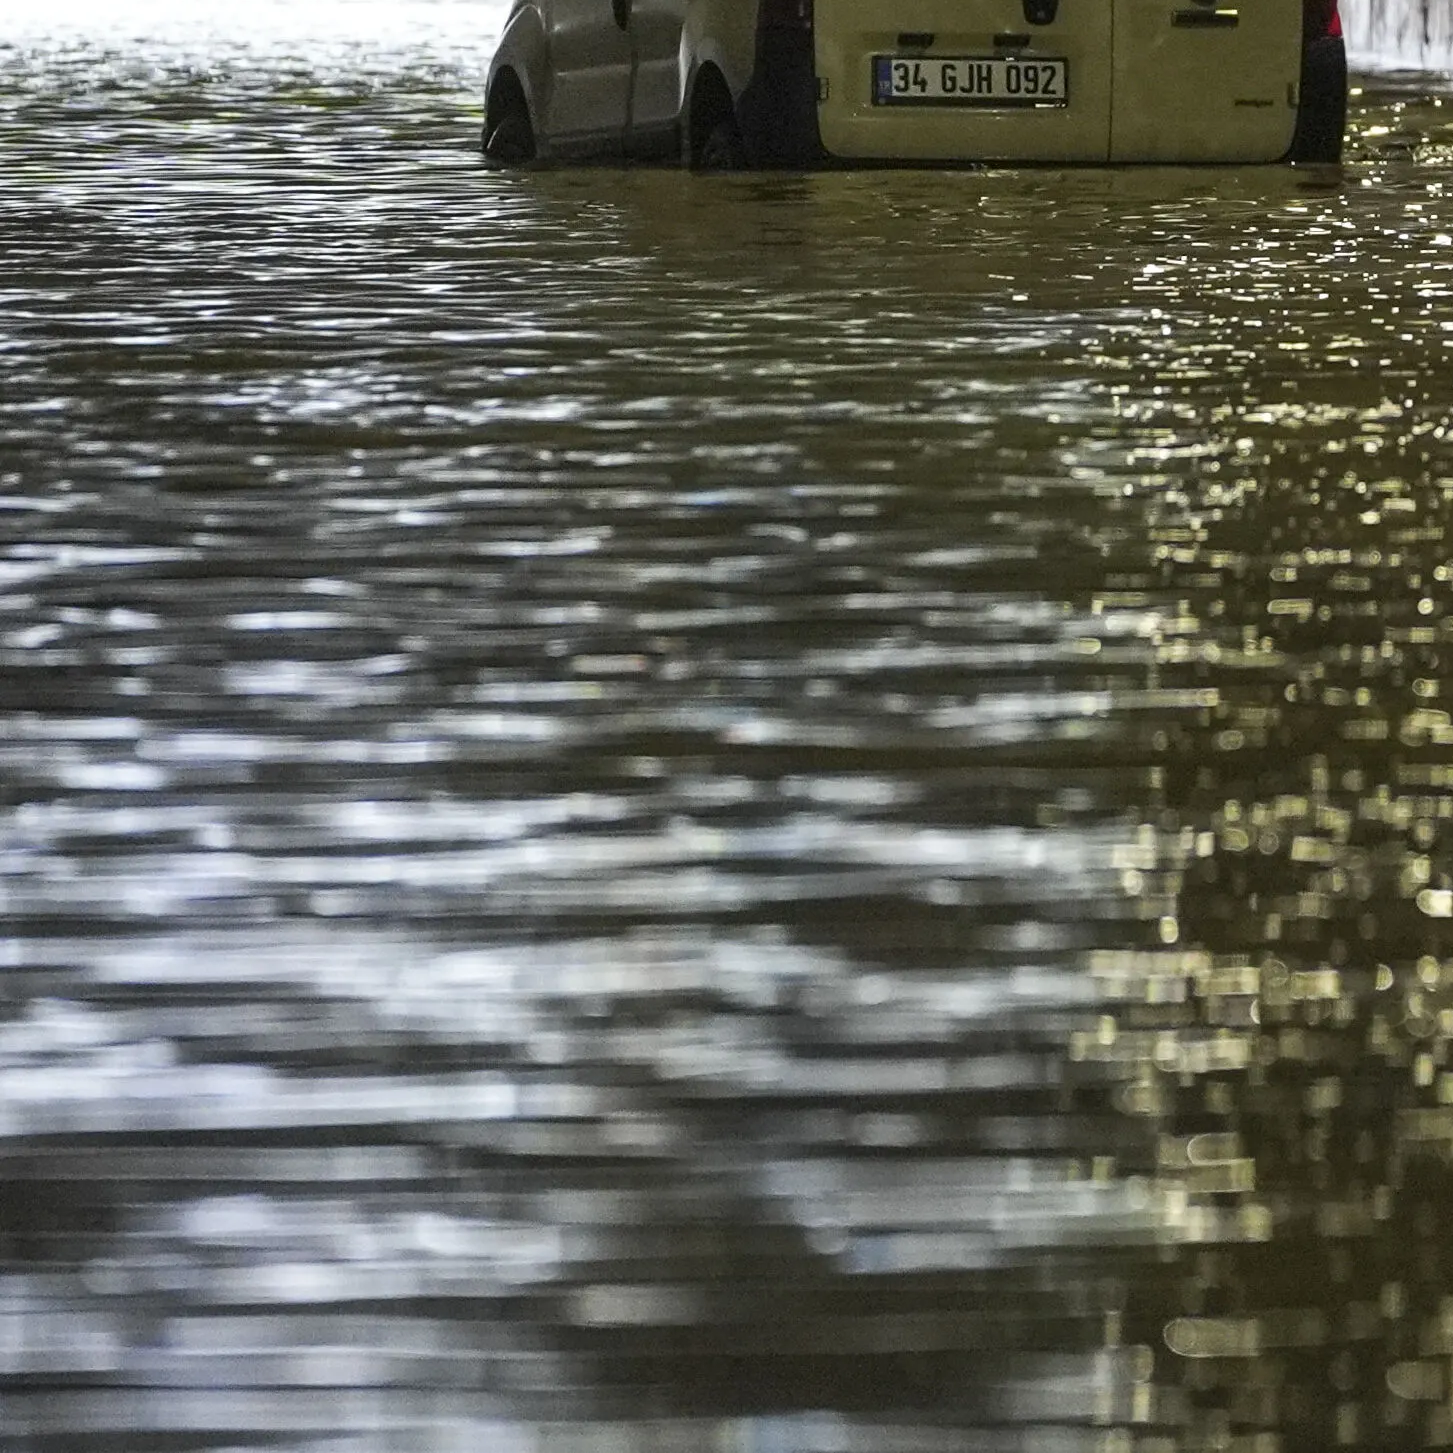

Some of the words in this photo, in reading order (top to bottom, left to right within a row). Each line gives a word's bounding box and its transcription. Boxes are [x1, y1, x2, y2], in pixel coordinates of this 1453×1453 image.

[893, 62, 928, 93] 34
[941, 63, 993, 94] GJH
[1005, 64, 1057, 95] 092
